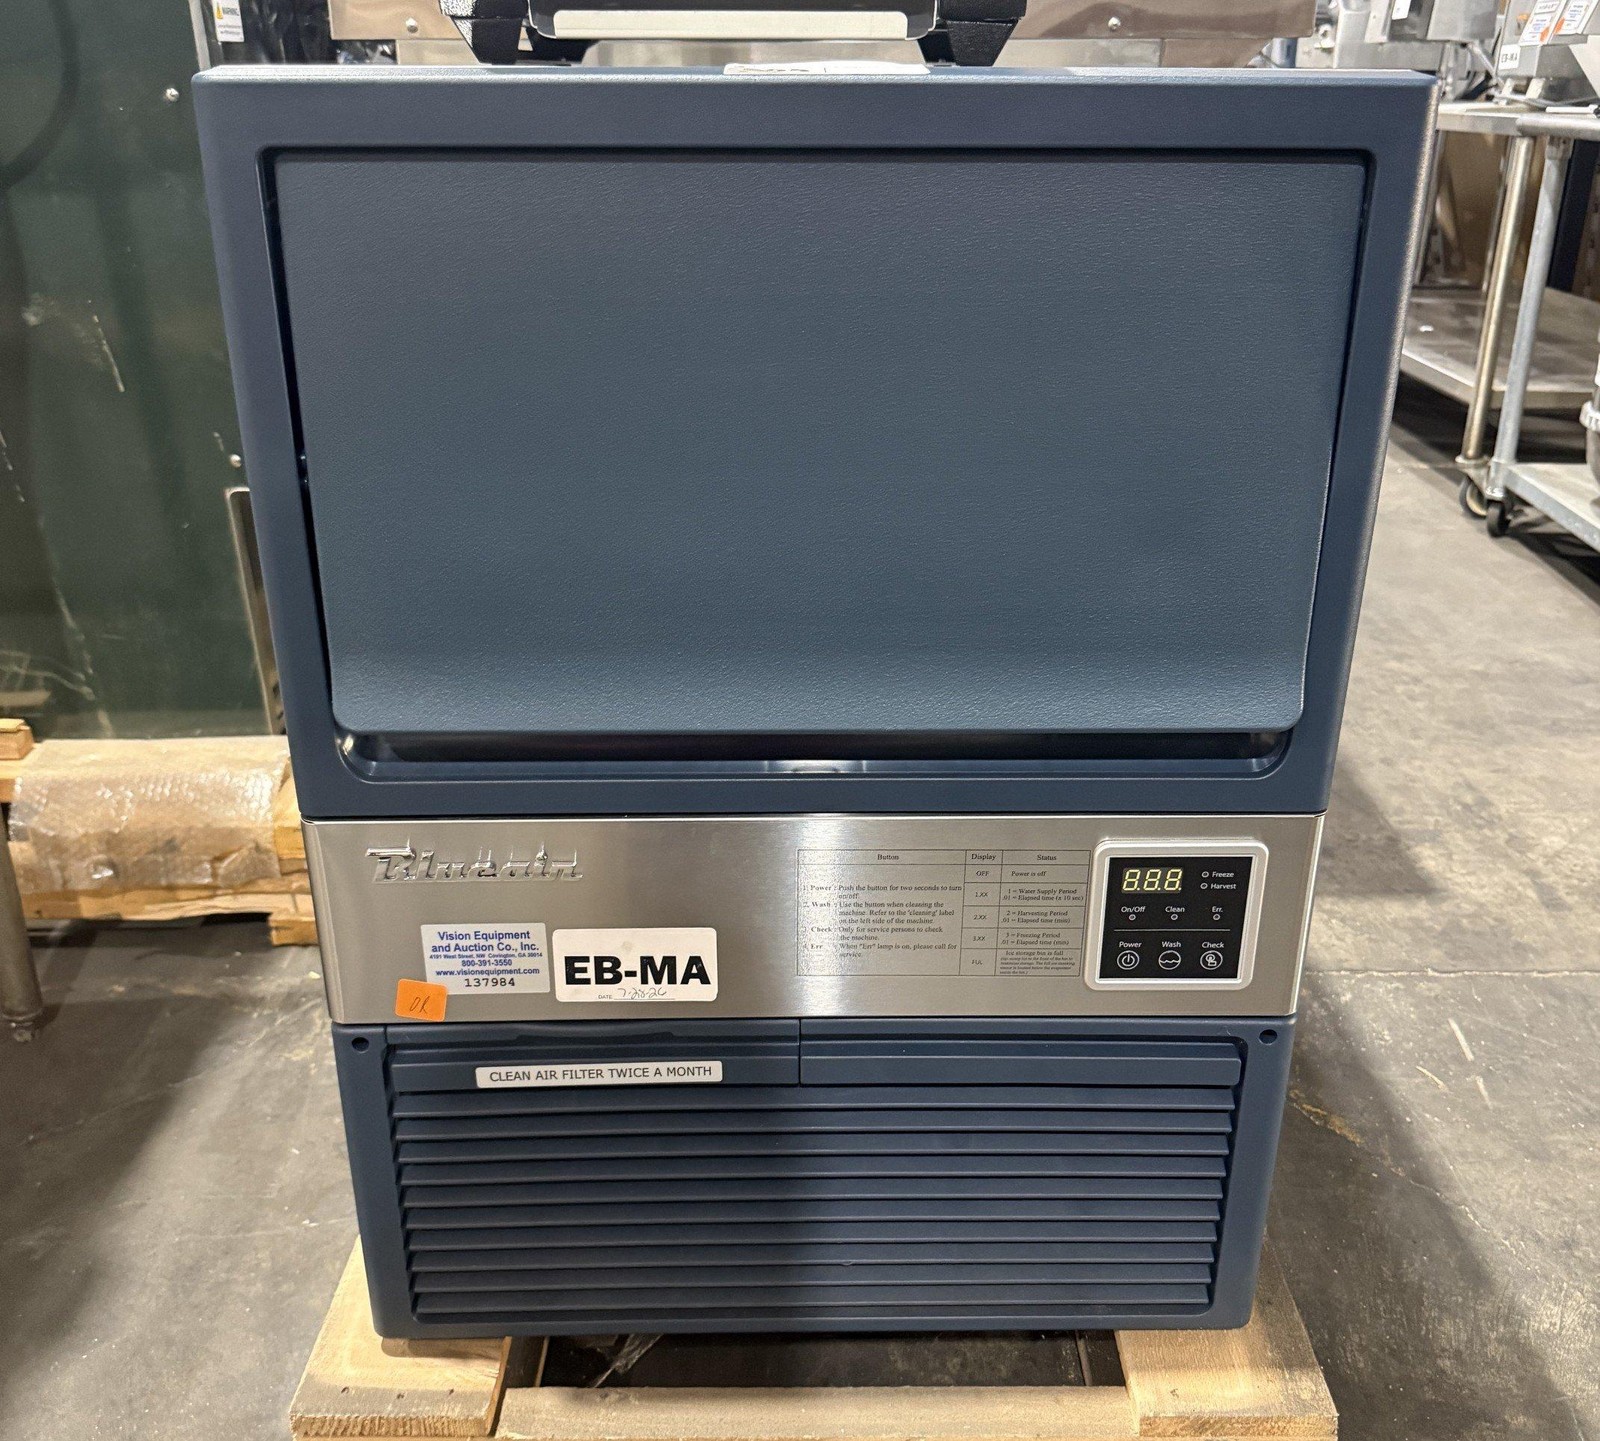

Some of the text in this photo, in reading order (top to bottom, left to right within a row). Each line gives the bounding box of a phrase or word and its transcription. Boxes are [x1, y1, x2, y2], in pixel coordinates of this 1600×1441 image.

[438, 931, 530, 941] Vision Equipment
[431, 942, 539, 953] and Auction Co., Inc.
[913, 943, 933, 951] please
[461, 959, 513, 967] 800-391-3550
[436, 968, 540, 976] www.visionequipment.com
[564, 955, 711, 985] EB-MA
[465, 978, 516, 987] 137984
[489, 1066, 712, 1082] CLEAN AIR FILTER TWICE A MONTH
